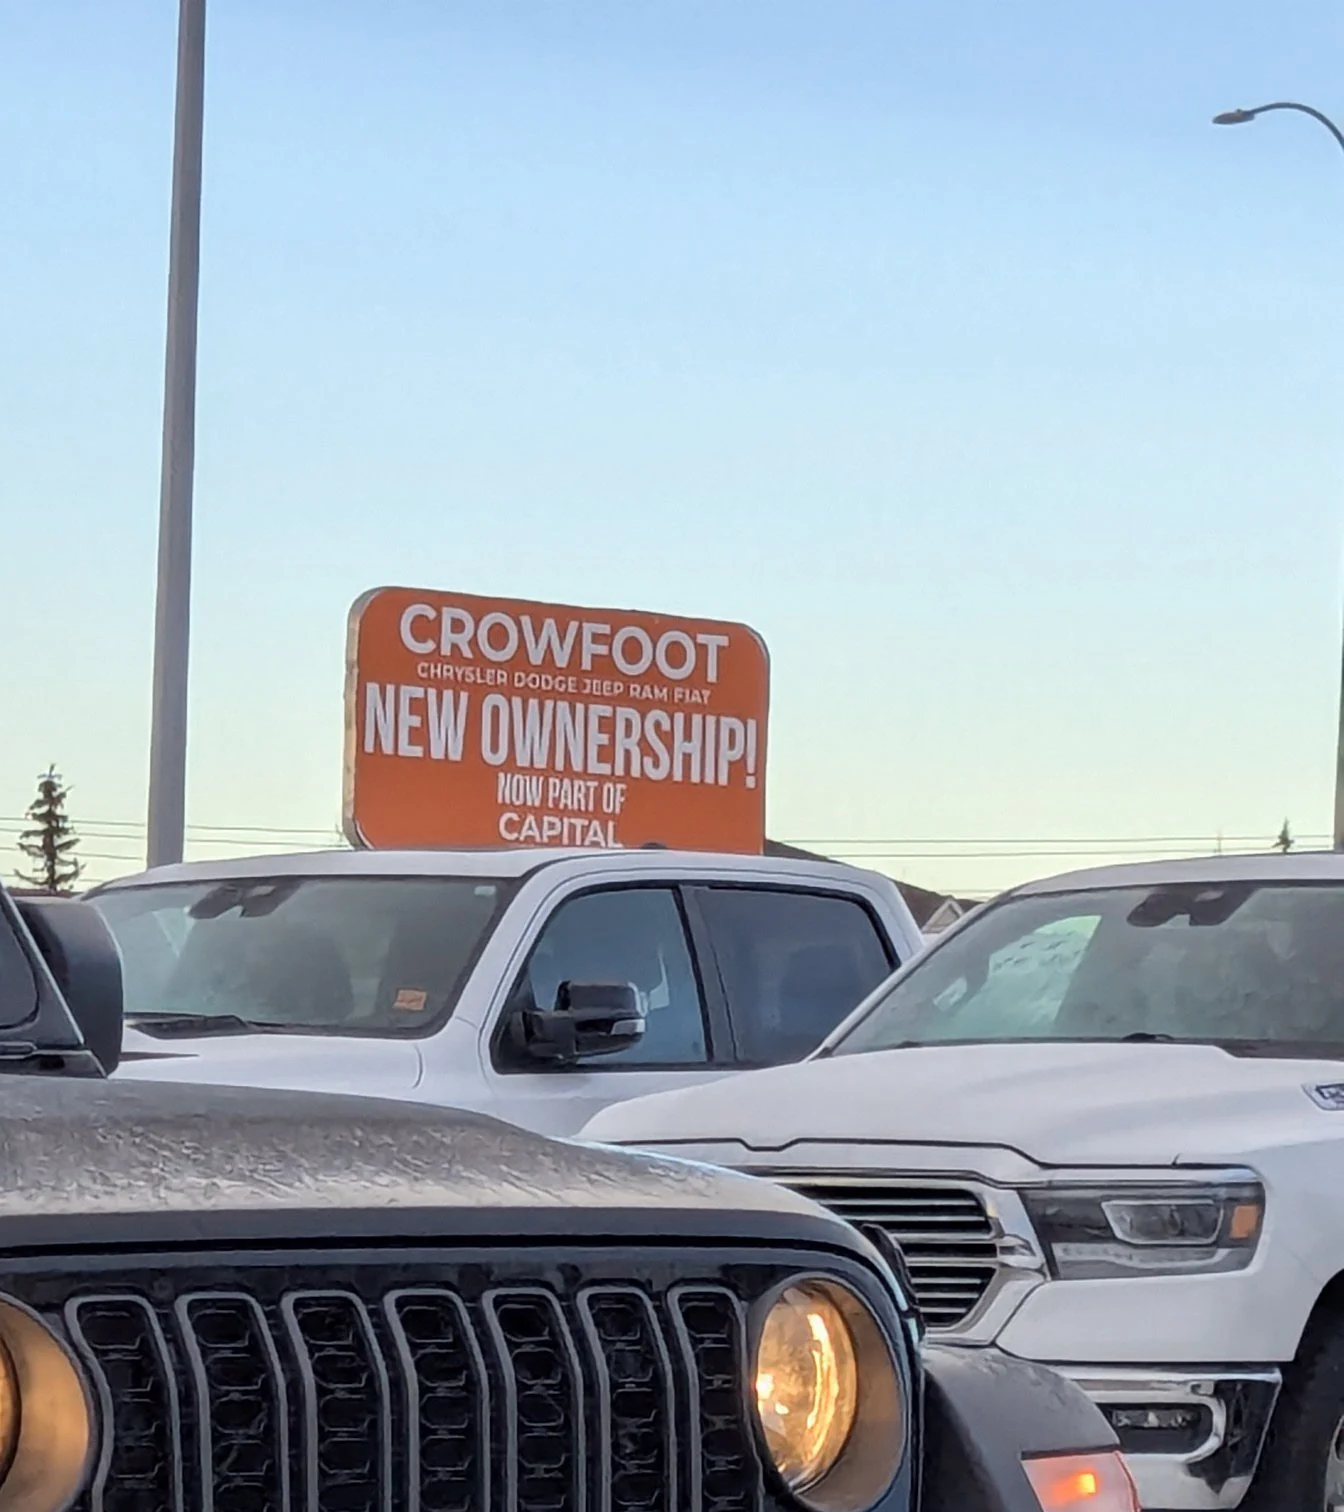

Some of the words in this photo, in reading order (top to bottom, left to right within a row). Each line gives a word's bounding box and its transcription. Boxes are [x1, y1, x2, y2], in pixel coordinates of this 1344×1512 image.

[400, 603, 729, 683] CROWFOOT
[417, 661, 508, 686] CHRYSLER
[514, 672, 578, 693] DODGE
[582, 678, 624, 697] JEEP
[629, 683, 668, 702] RAM
[674, 686, 712, 705] FIAT
[364, 682, 468, 761] NEW
[481, 693, 757, 789] OWNERSHIP!
[497, 771, 544, 808] NOW
[547, 777, 599, 812] PART
[602, 781, 627, 815] OF
[499, 811, 624, 848] CAPITAL
